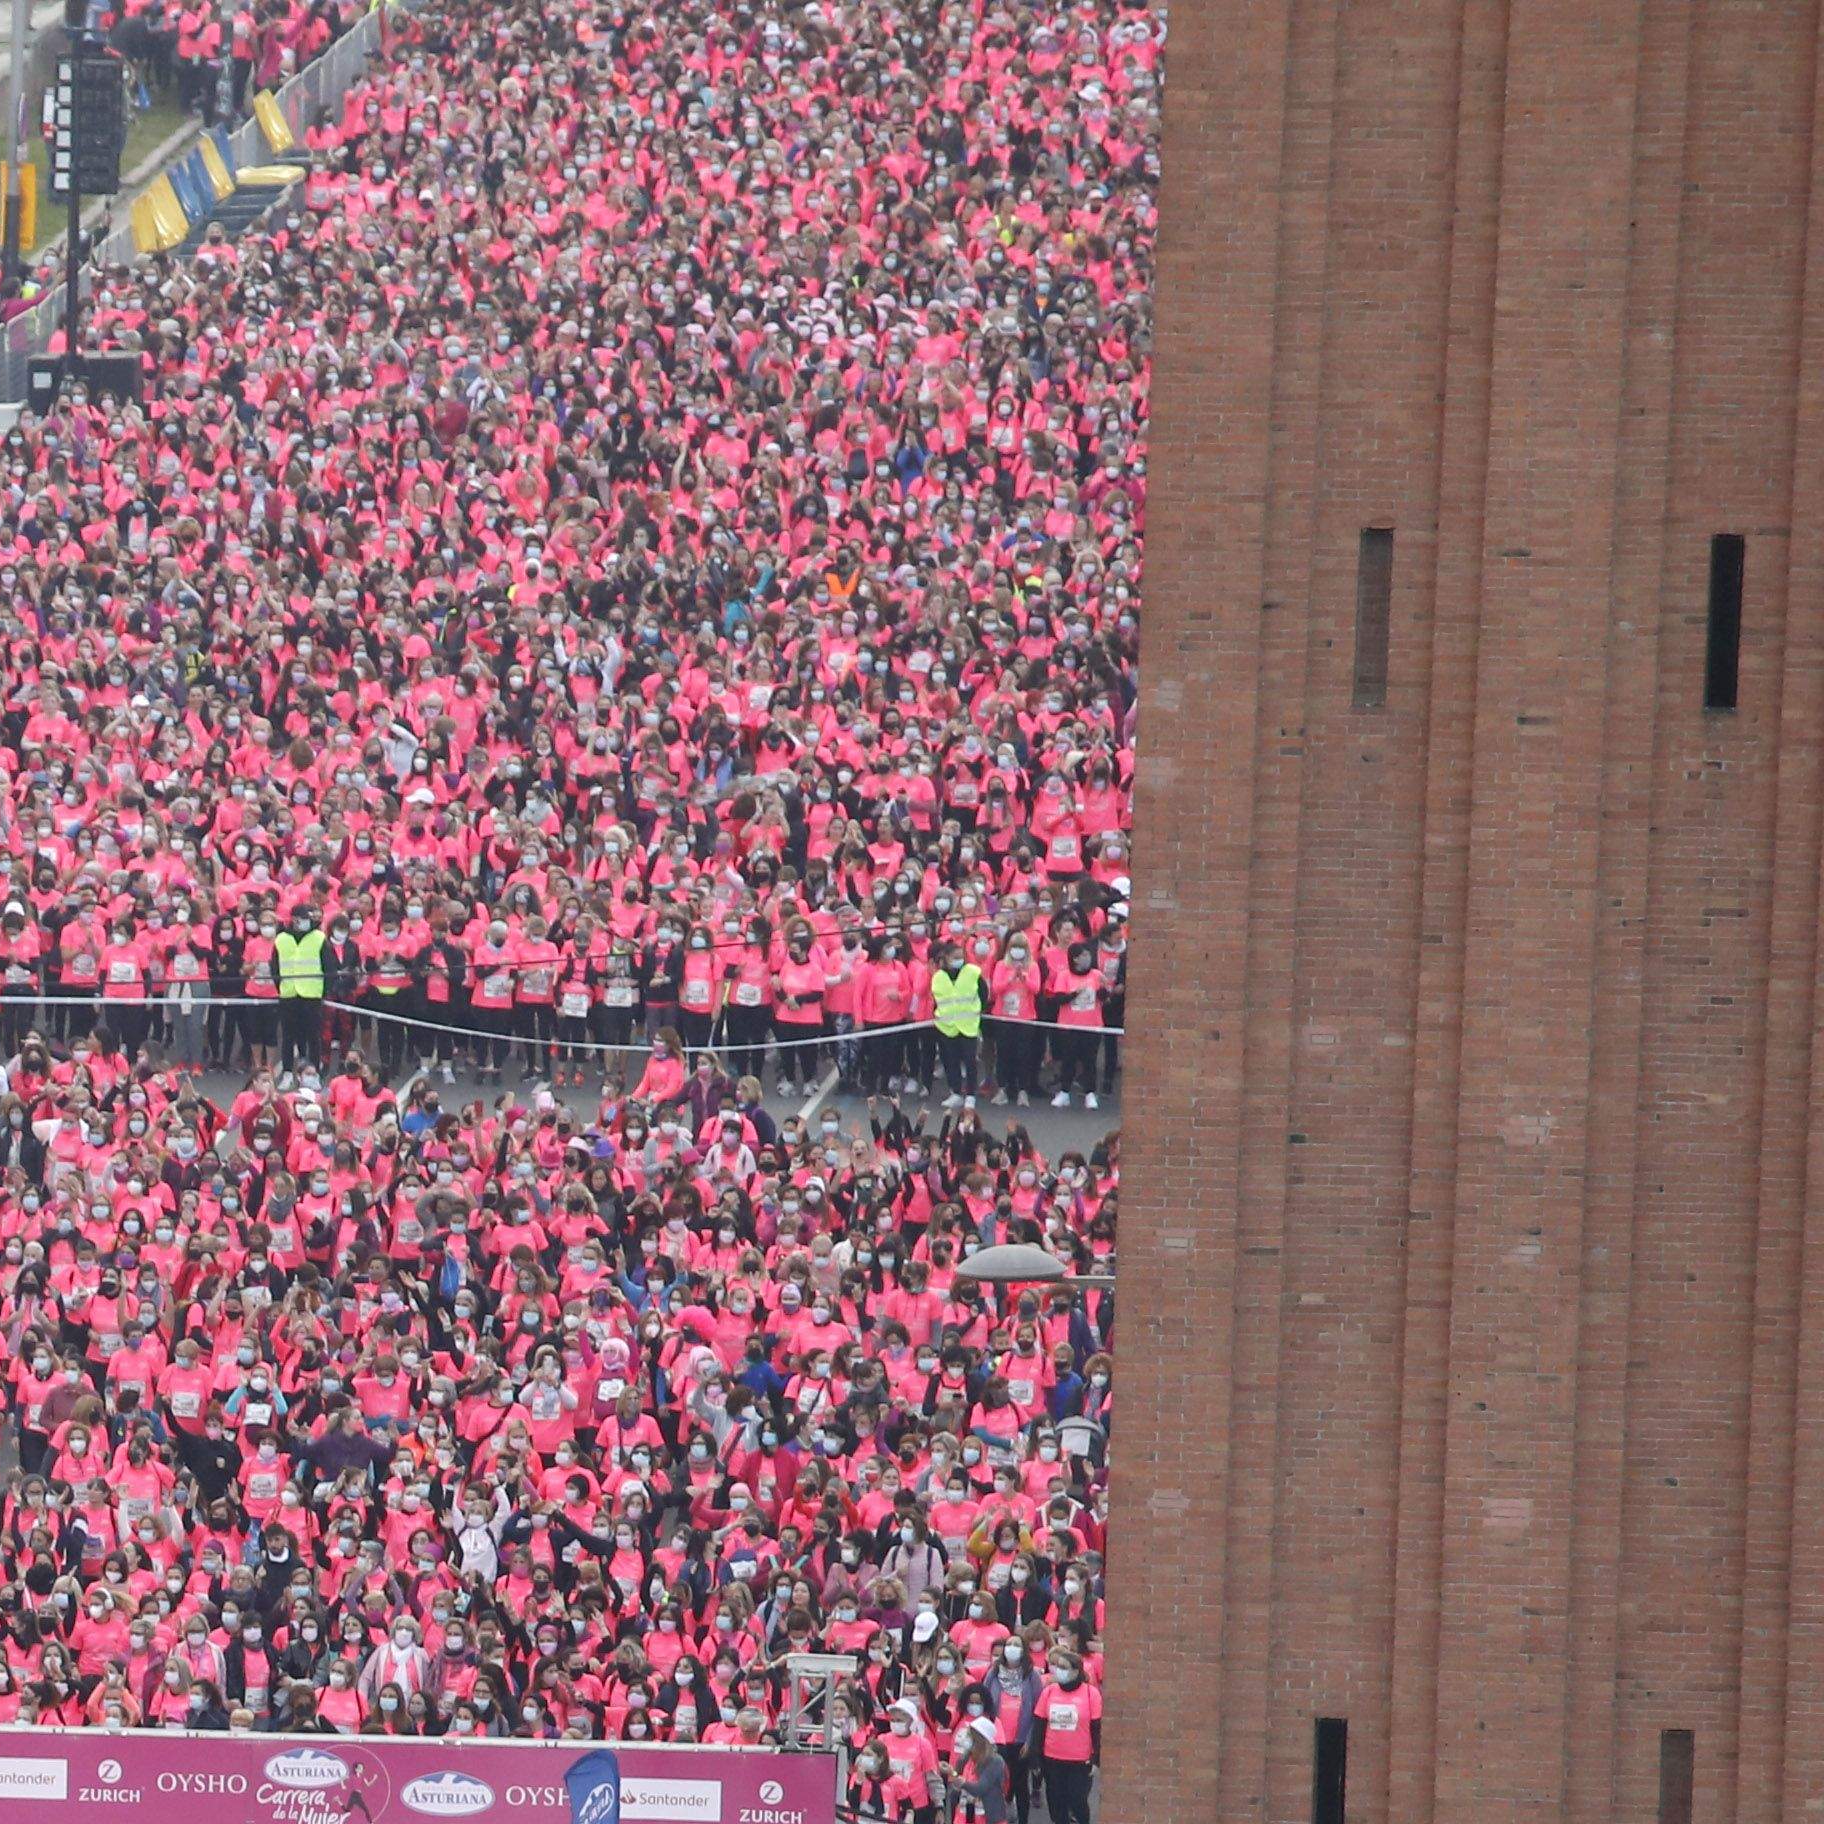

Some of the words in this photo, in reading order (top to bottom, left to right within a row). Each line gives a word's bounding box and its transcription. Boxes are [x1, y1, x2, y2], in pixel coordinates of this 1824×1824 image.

[270, 1762, 342, 1779] ASTURIANA
[156, 1772, 248, 1795] OYSHO
[78, 1787, 141, 1803] ZURICH
[256, 1783, 326, 1806] Carrera
[408, 1788, 488, 1806] ASTURIANA
[505, 1785, 569, 1808] OYSH
[639, 1791, 711, 1808] Santander
[739, 1808, 804, 1824] ZURICH
